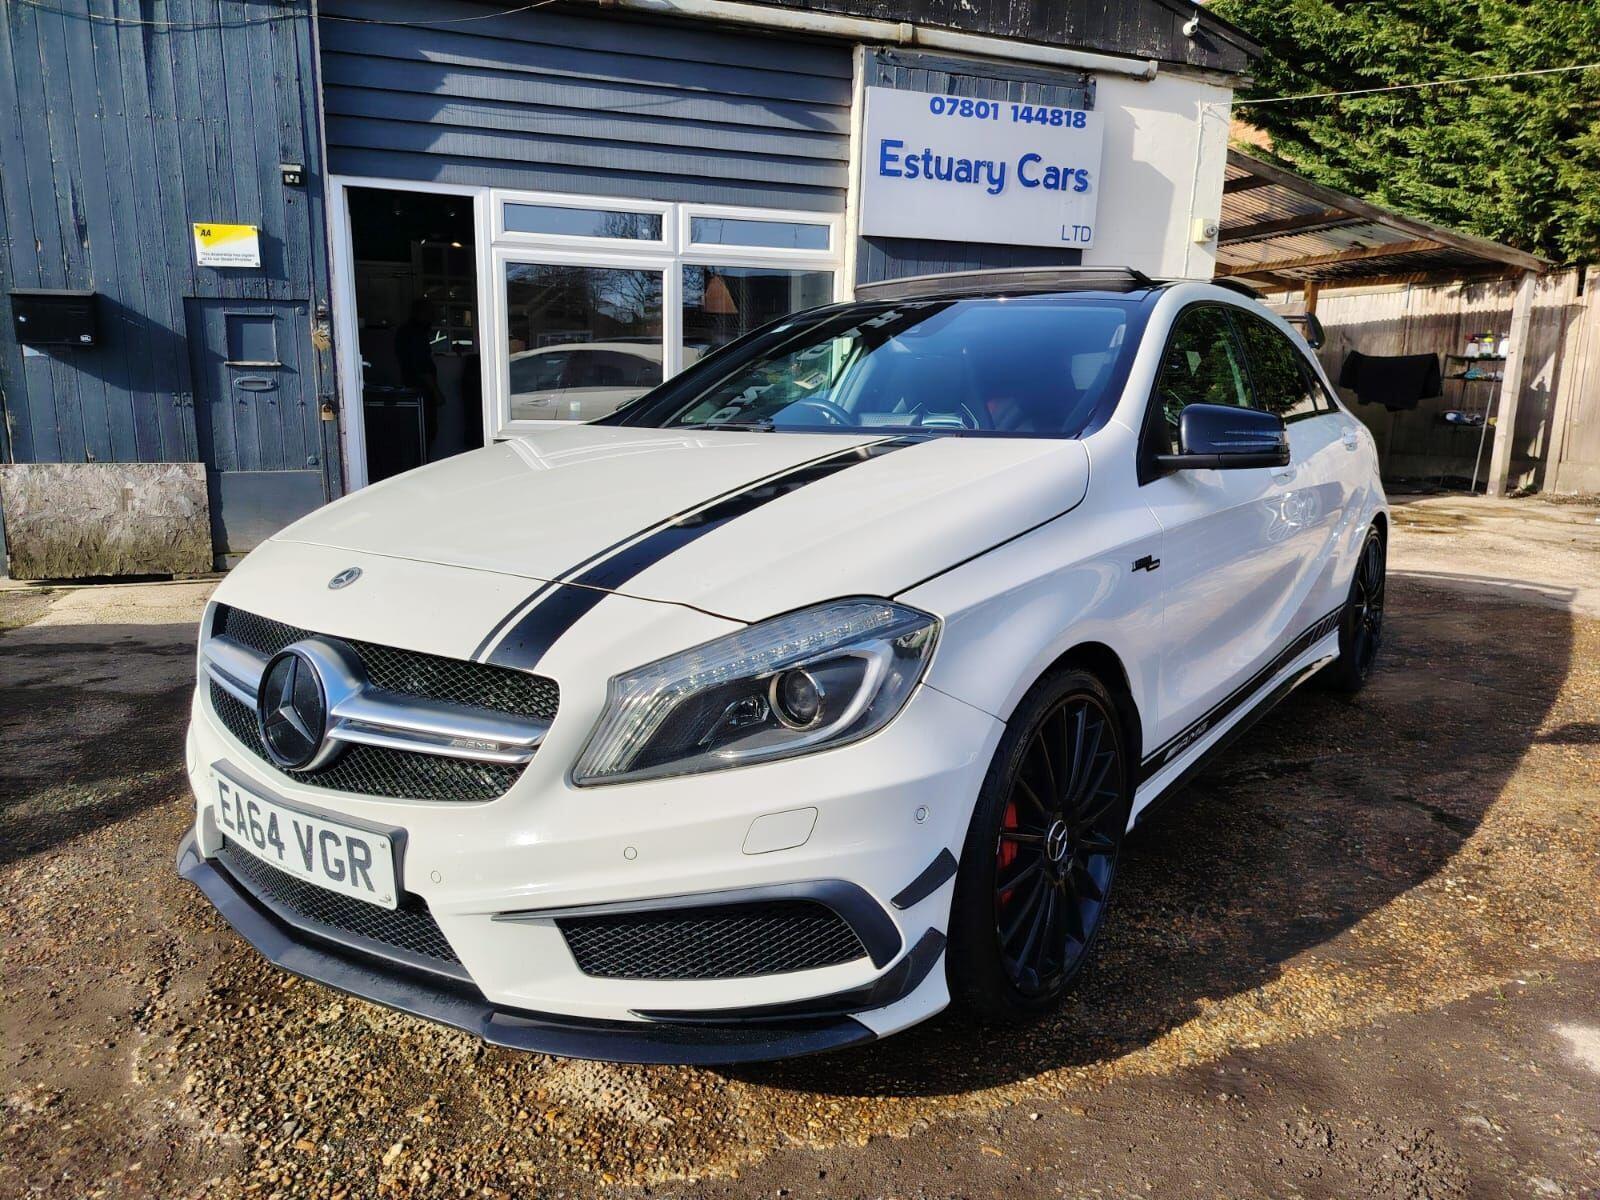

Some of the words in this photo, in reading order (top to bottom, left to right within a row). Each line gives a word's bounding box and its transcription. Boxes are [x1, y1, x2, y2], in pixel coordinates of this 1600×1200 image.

[930, 97, 999, 120] 07801
[1012, 105, 1086, 128] 144818
[880, 139, 1006, 194] Estuary
[1017, 153, 1089, 192] Cars
[200, 229, 211, 237] AA
[1061, 224, 1092, 242] LTD
[218, 779, 285, 860] EA64
[292, 820, 375, 892] VGR
